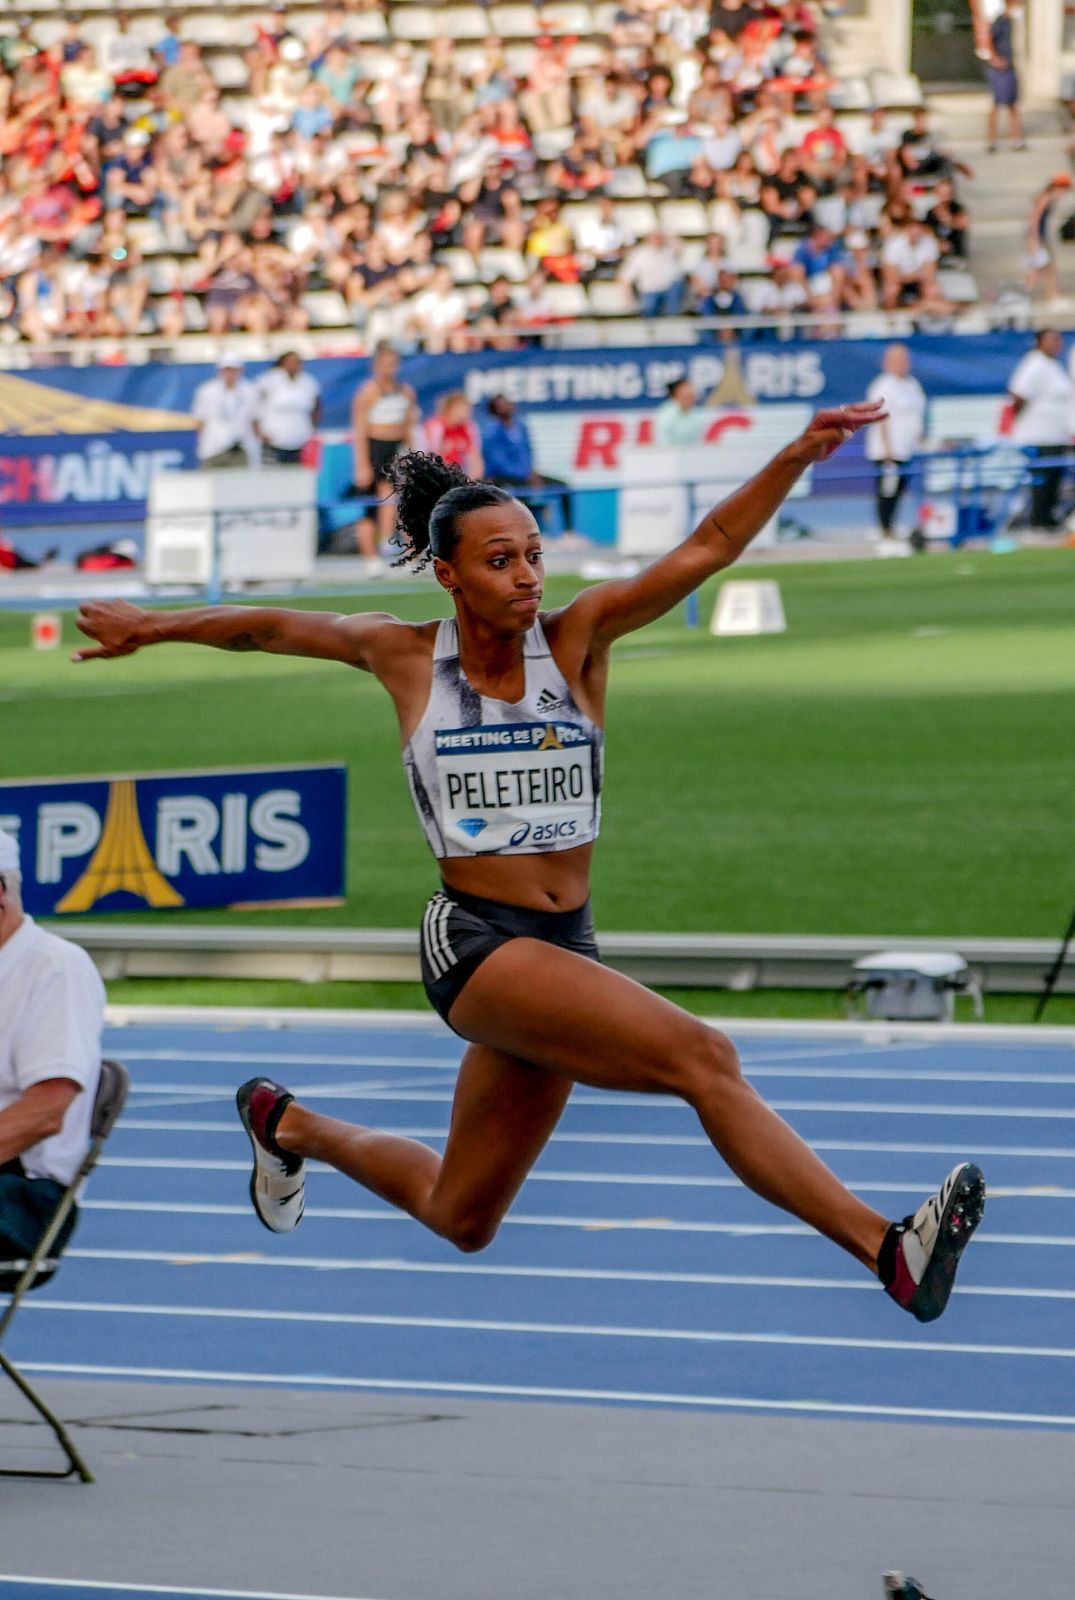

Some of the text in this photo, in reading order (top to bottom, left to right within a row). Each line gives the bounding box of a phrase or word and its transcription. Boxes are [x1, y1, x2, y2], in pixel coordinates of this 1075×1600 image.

[465, 361, 644, 404] MEETING
[689, 347, 825, 407] PARIS
[436, 730, 512, 748] MEETING
[447, 763, 584, 810] PELETEIRO
[36, 779, 311, 913] PARIS
[532, 820, 578, 841] asics
